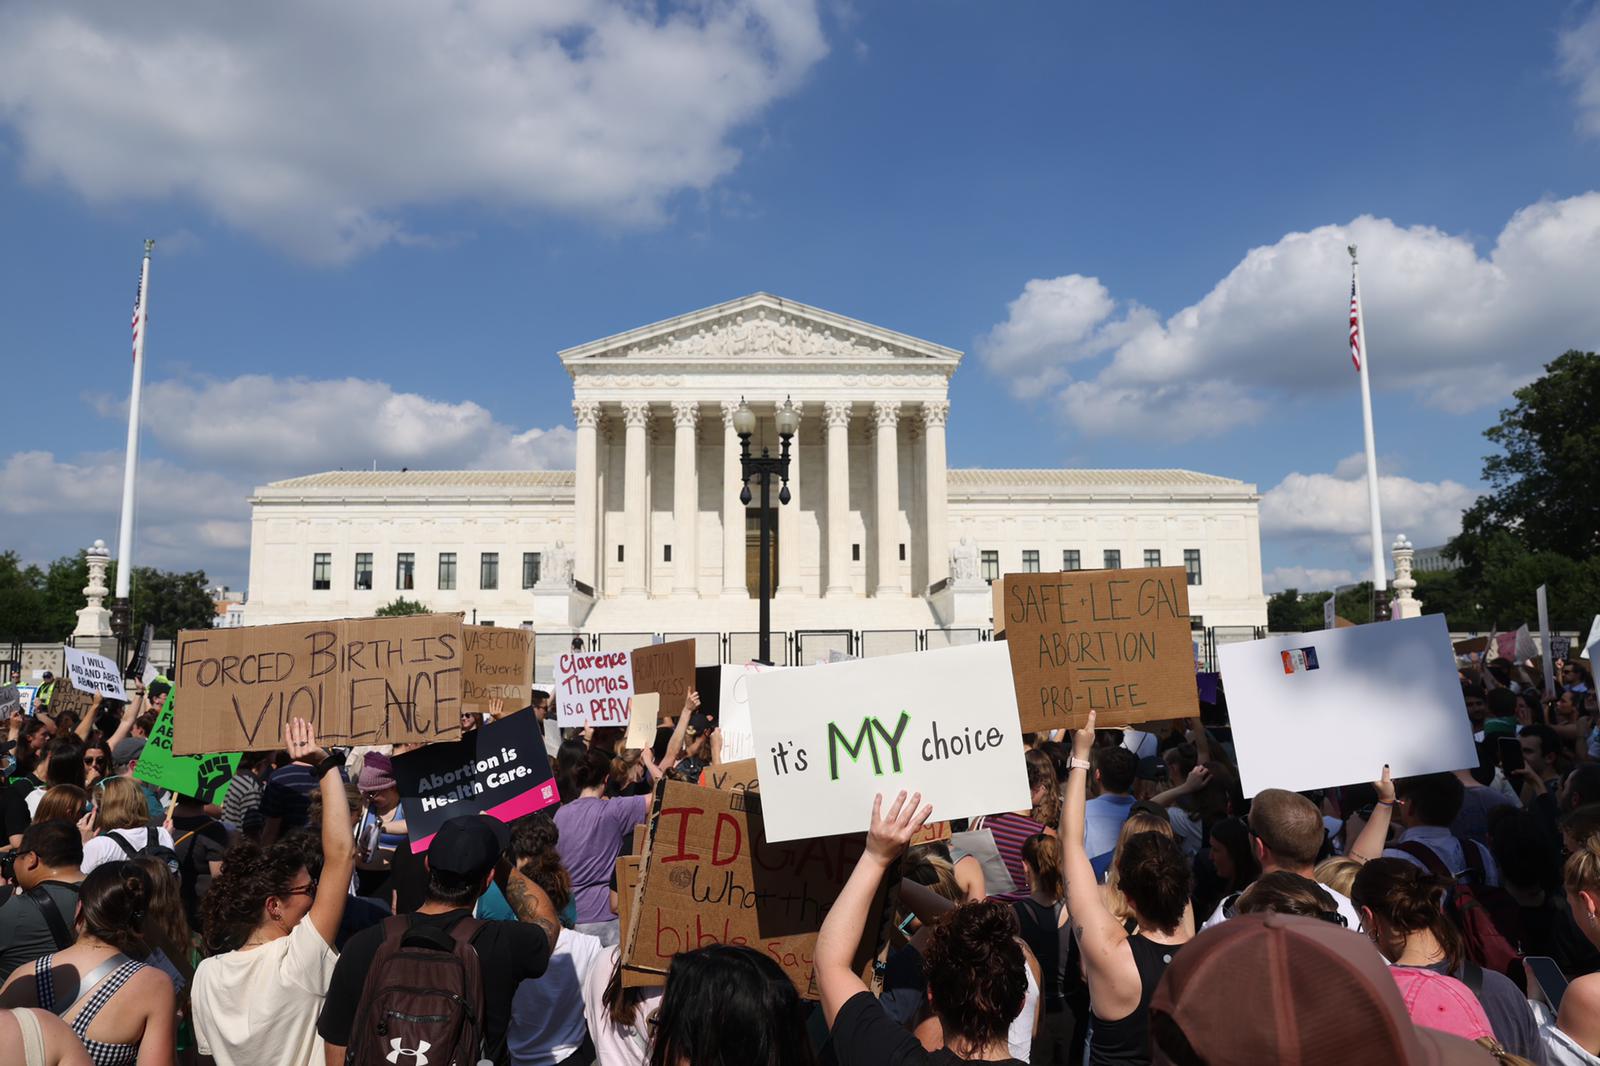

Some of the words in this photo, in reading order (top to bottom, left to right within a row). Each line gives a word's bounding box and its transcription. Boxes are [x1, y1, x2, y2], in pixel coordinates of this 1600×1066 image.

[1011, 583, 1078, 624] SAFE
[1089, 578, 1191, 622] LEGAL
[180, 638, 295, 688] FORCED
[304, 631, 404, 678] BIRTH
[408, 633, 457, 663] IS
[463, 631, 534, 654] VASECTOMY
[1039, 630, 1156, 670] ABORTION
[71, 663, 85, 675] AID
[84, 668, 101, 680] AND
[102, 672, 120, 684] ABET
[87, 657, 107, 670] WILL
[560, 652, 628, 674] Clarence
[77, 677, 121, 694] ABORTION
[561, 674, 629, 696] Thomas
[1040, 683, 1147, 718] PRO-LIFE
[231, 667, 462, 747] VIOLENCE
[575, 702, 585, 715] a
[589, 697, 631, 722] PERV
[770, 740, 808, 776] it's
[827, 709, 912, 781] MY
[921, 721, 1004, 761] choice
[418, 754, 499, 794] Abortion
[501, 747, 518, 764] is
[421, 780, 484, 812] Health
[486, 765, 532, 789] Care.
[692, 865, 777, 909] What
